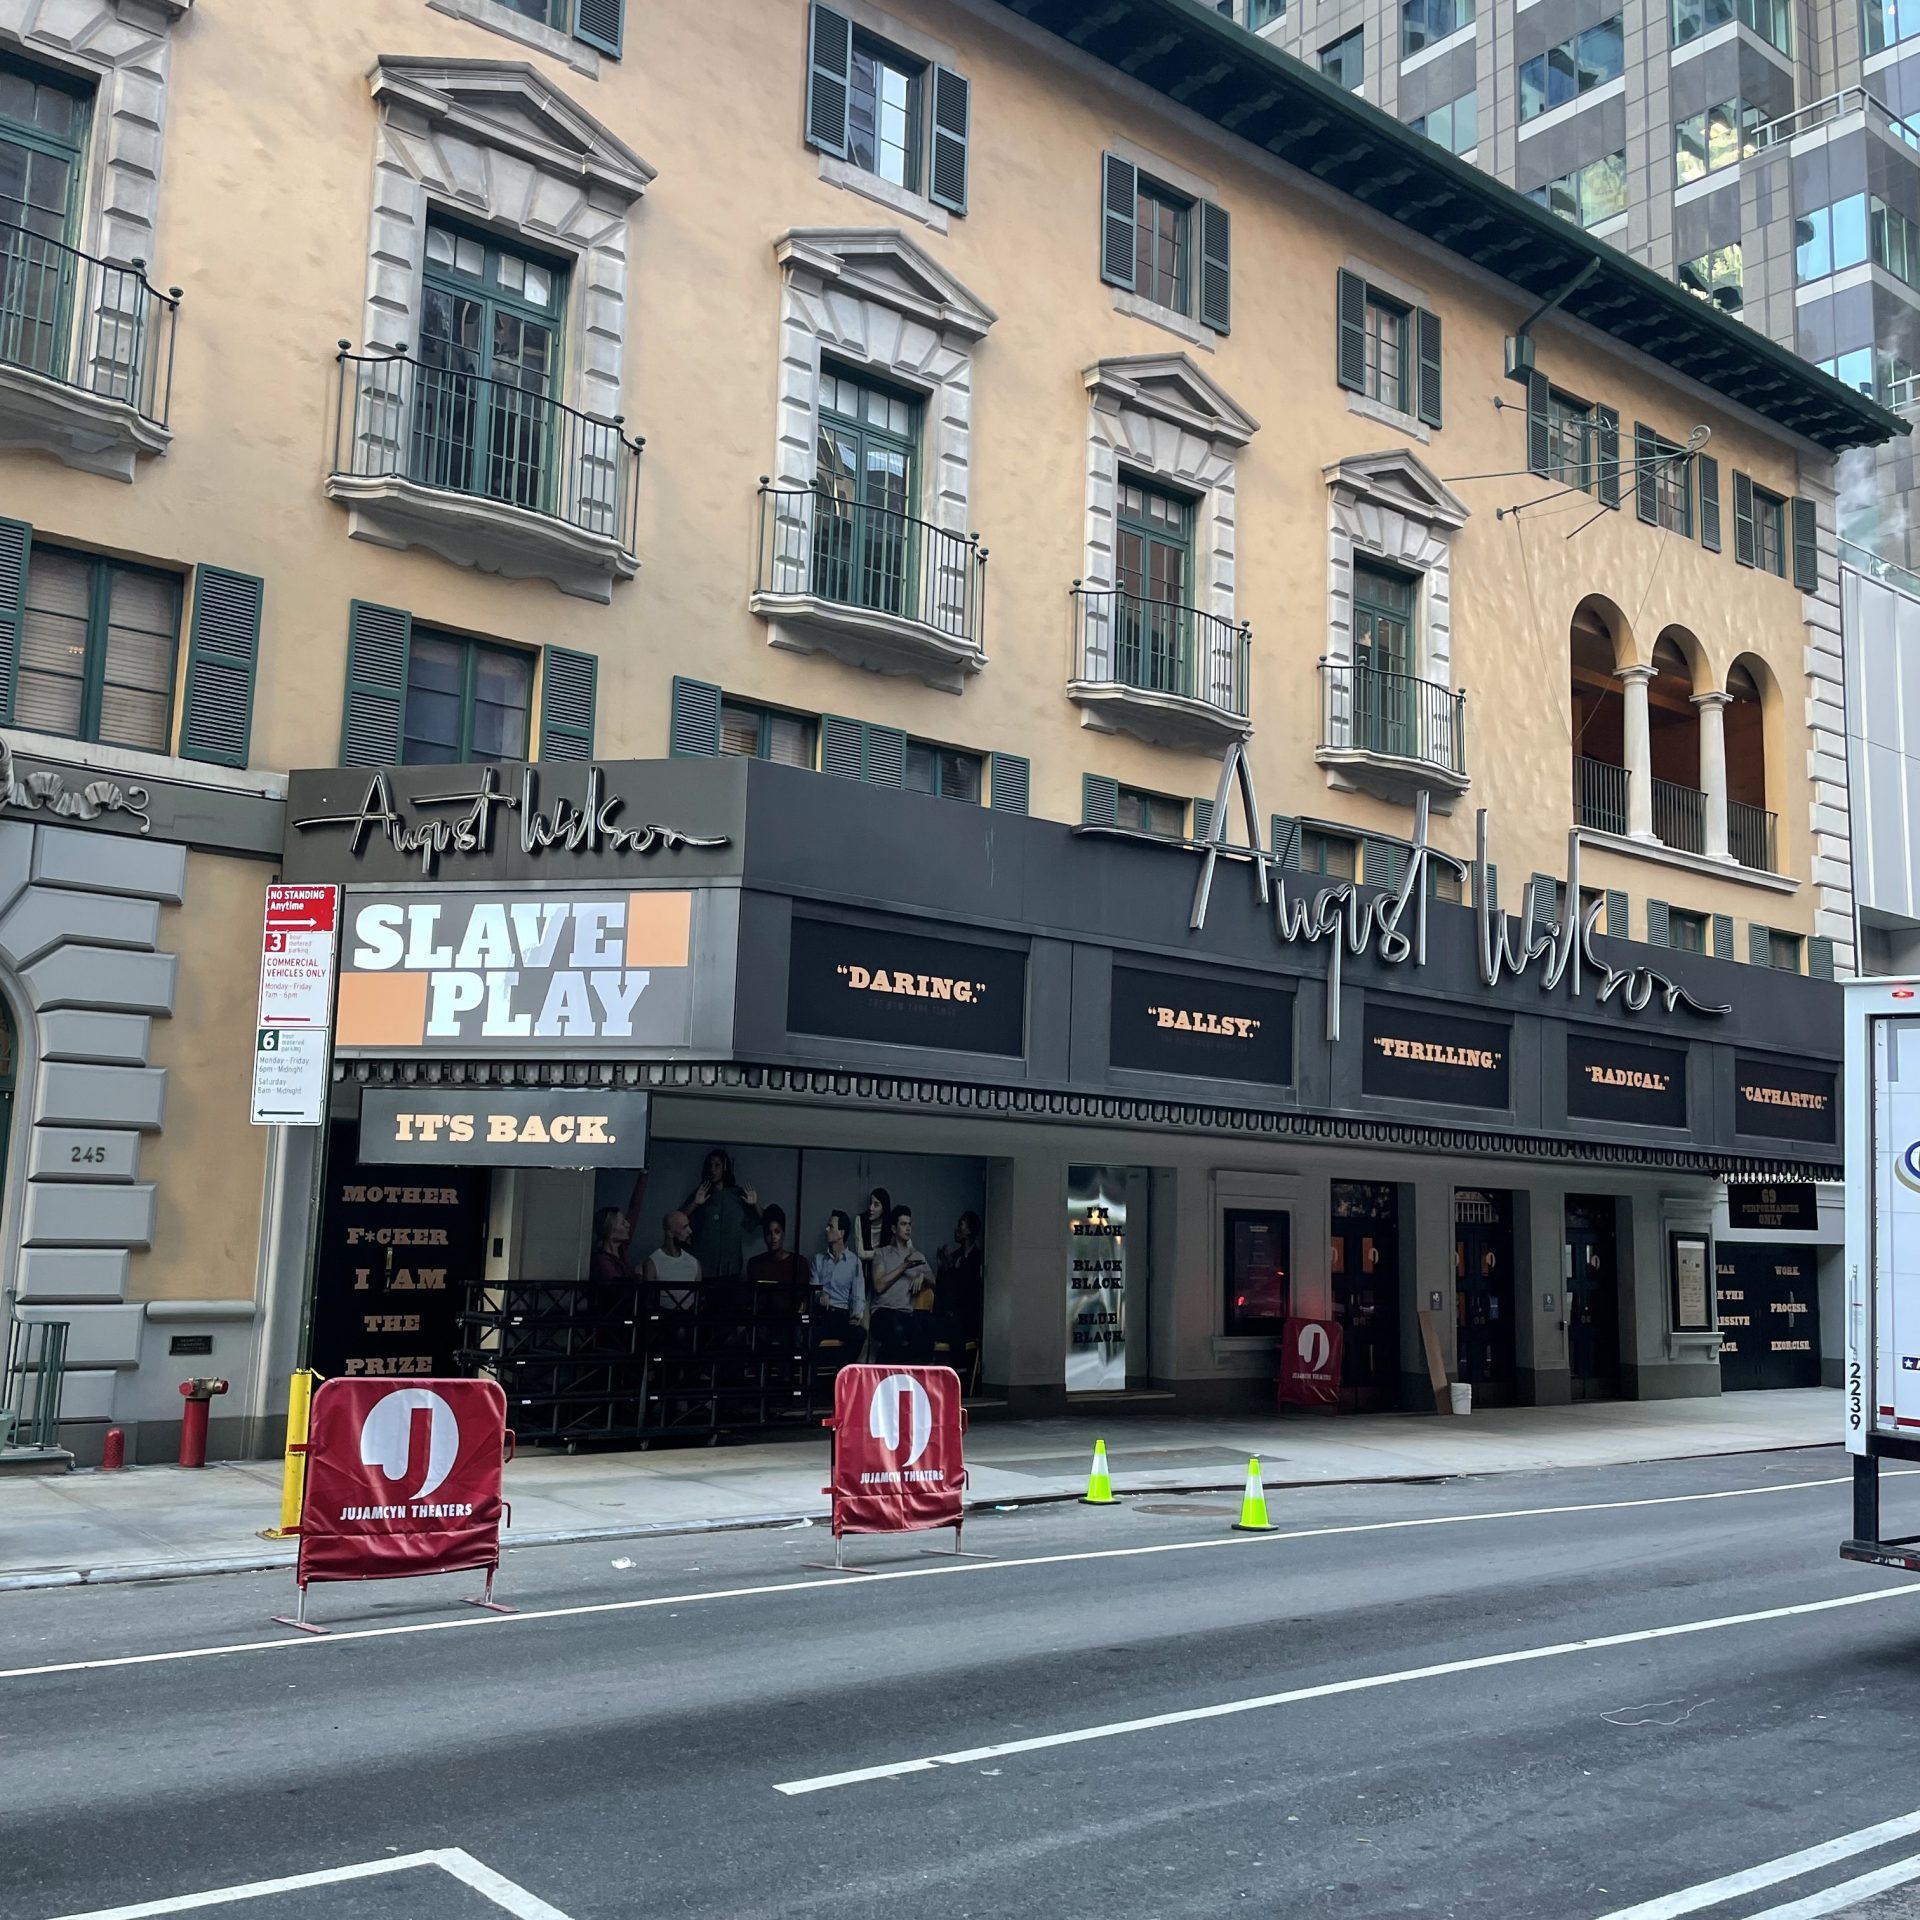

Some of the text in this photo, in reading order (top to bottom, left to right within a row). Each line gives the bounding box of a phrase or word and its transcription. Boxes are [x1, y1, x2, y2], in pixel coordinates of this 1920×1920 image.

[291, 766, 518, 874] August
[270, 890, 325, 900] NO STANDING
[1070, 742, 1468, 1042] August
[270, 901, 305, 912] Anytime
[270, 933, 282, 951] 3
[353, 902, 626, 970] SLAVE
[266, 958, 319, 967] COMMERCIAL
[267, 968, 326, 978] VEHICLES ONLY
[265, 982, 288, 991] Monday
[293, 982, 312, 991] Friday
[836, 964, 986, 1003] "DARING."
[426, 970, 650, 1038] PLAY
[1147, 1006, 1261, 1039] "BALLSY."
[262, 1031, 275, 1050] 6
[259, 1056, 285, 1065] Monday
[289, 1057, 309, 1065] Friday
[1373, 1036, 1502, 1069] "THRILLING."
[258, 1077, 287, 1086] Saturday
[1585, 1065, 1670, 1091] "RADICAL."
[1740, 1086, 1828, 1110] "CATHARTIC."
[394, 1113, 616, 1144] IT'S BACK.
[71, 1146, 106, 1163] 245
[342, 1185, 459, 1205] MOTHER
[1758, 1214, 1783, 1226] ONLY
[1073, 1225, 1125, 1237] BLACK.
[1072, 1260, 1123, 1272] BLACK
[354, 1268, 447, 1290] I AM
[1071, 1277, 1123, 1290] BLACK.
[1770, 1303, 1808, 1313] PROCESS.
[363, 1315, 420, 1332] THE
[1077, 1313, 1118, 1325] BLUE
[1072, 1331, 1125, 1343] BLACK.
[344, 1356, 433, 1376] PRIZE
[1849, 1362, 1862, 1431] 2239
[904, 1469, 944, 1483] THEATERS
[340, 1503, 473, 1521] JUJAMCYN THEATERS
